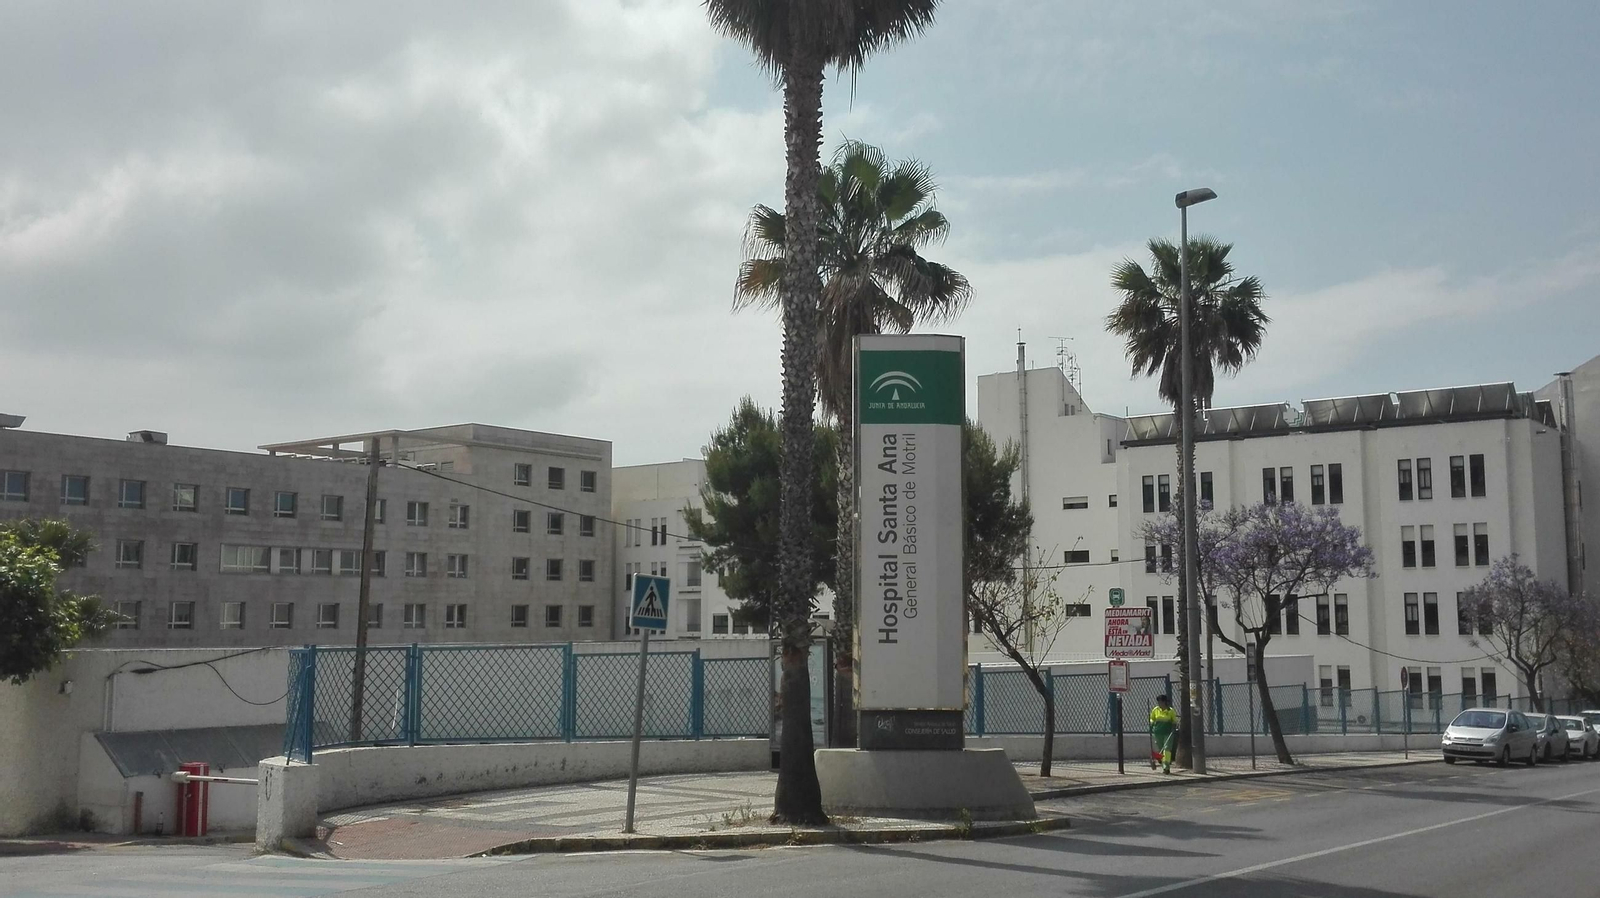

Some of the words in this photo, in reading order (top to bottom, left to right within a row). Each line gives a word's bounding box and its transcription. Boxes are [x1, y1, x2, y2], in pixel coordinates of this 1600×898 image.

[877, 433, 898, 475] Ana
[901, 433, 916, 475] Motril
[901, 481, 916, 500] de
[877, 483, 898, 544] Santa
[902, 505, 917, 555] Básico
[878, 554, 903, 644] Hospital
[902, 561, 918, 619] General
[1105, 609, 1151, 617] MEDIAMARKT
[1108, 635, 1150, 646] NEVADA
